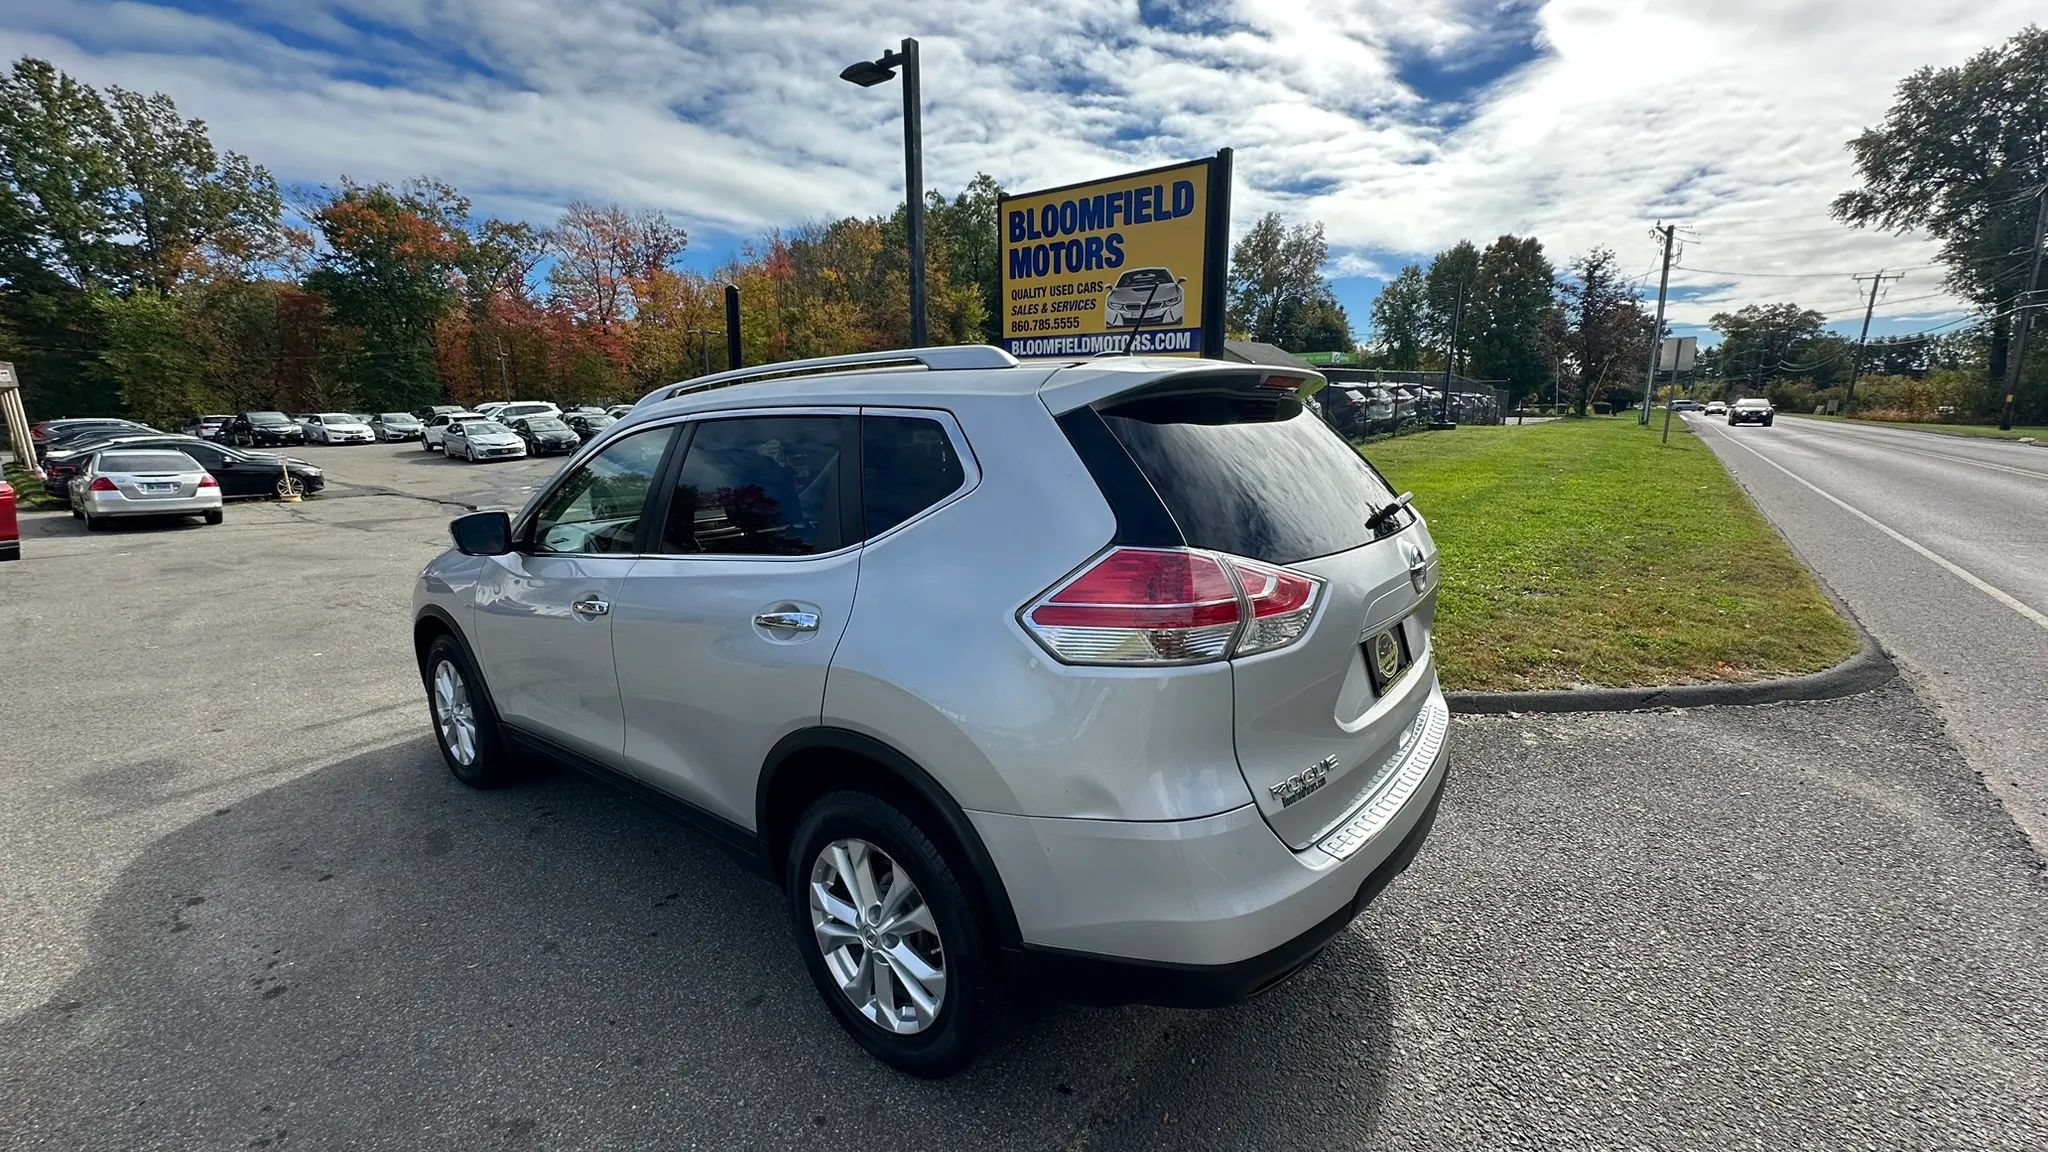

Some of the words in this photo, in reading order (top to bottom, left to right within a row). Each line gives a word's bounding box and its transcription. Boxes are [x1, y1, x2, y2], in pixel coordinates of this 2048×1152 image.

[1009, 180, 1195, 243] BLOOMFIELD
[1009, 233, 1125, 280] MOTORS
[1011, 287, 1047, 300] QUALITY
[1049, 285, 1074, 298] USED
[1077, 281, 1104, 294] CARS
[1011, 303, 1039, 316] SALES
[1041, 303, 1049, 313] &
[1050, 299, 1097, 312] SERVICES
[1011, 316, 1080, 332] 860.785.5555
[1268, 753, 1339, 801] ROGUE
